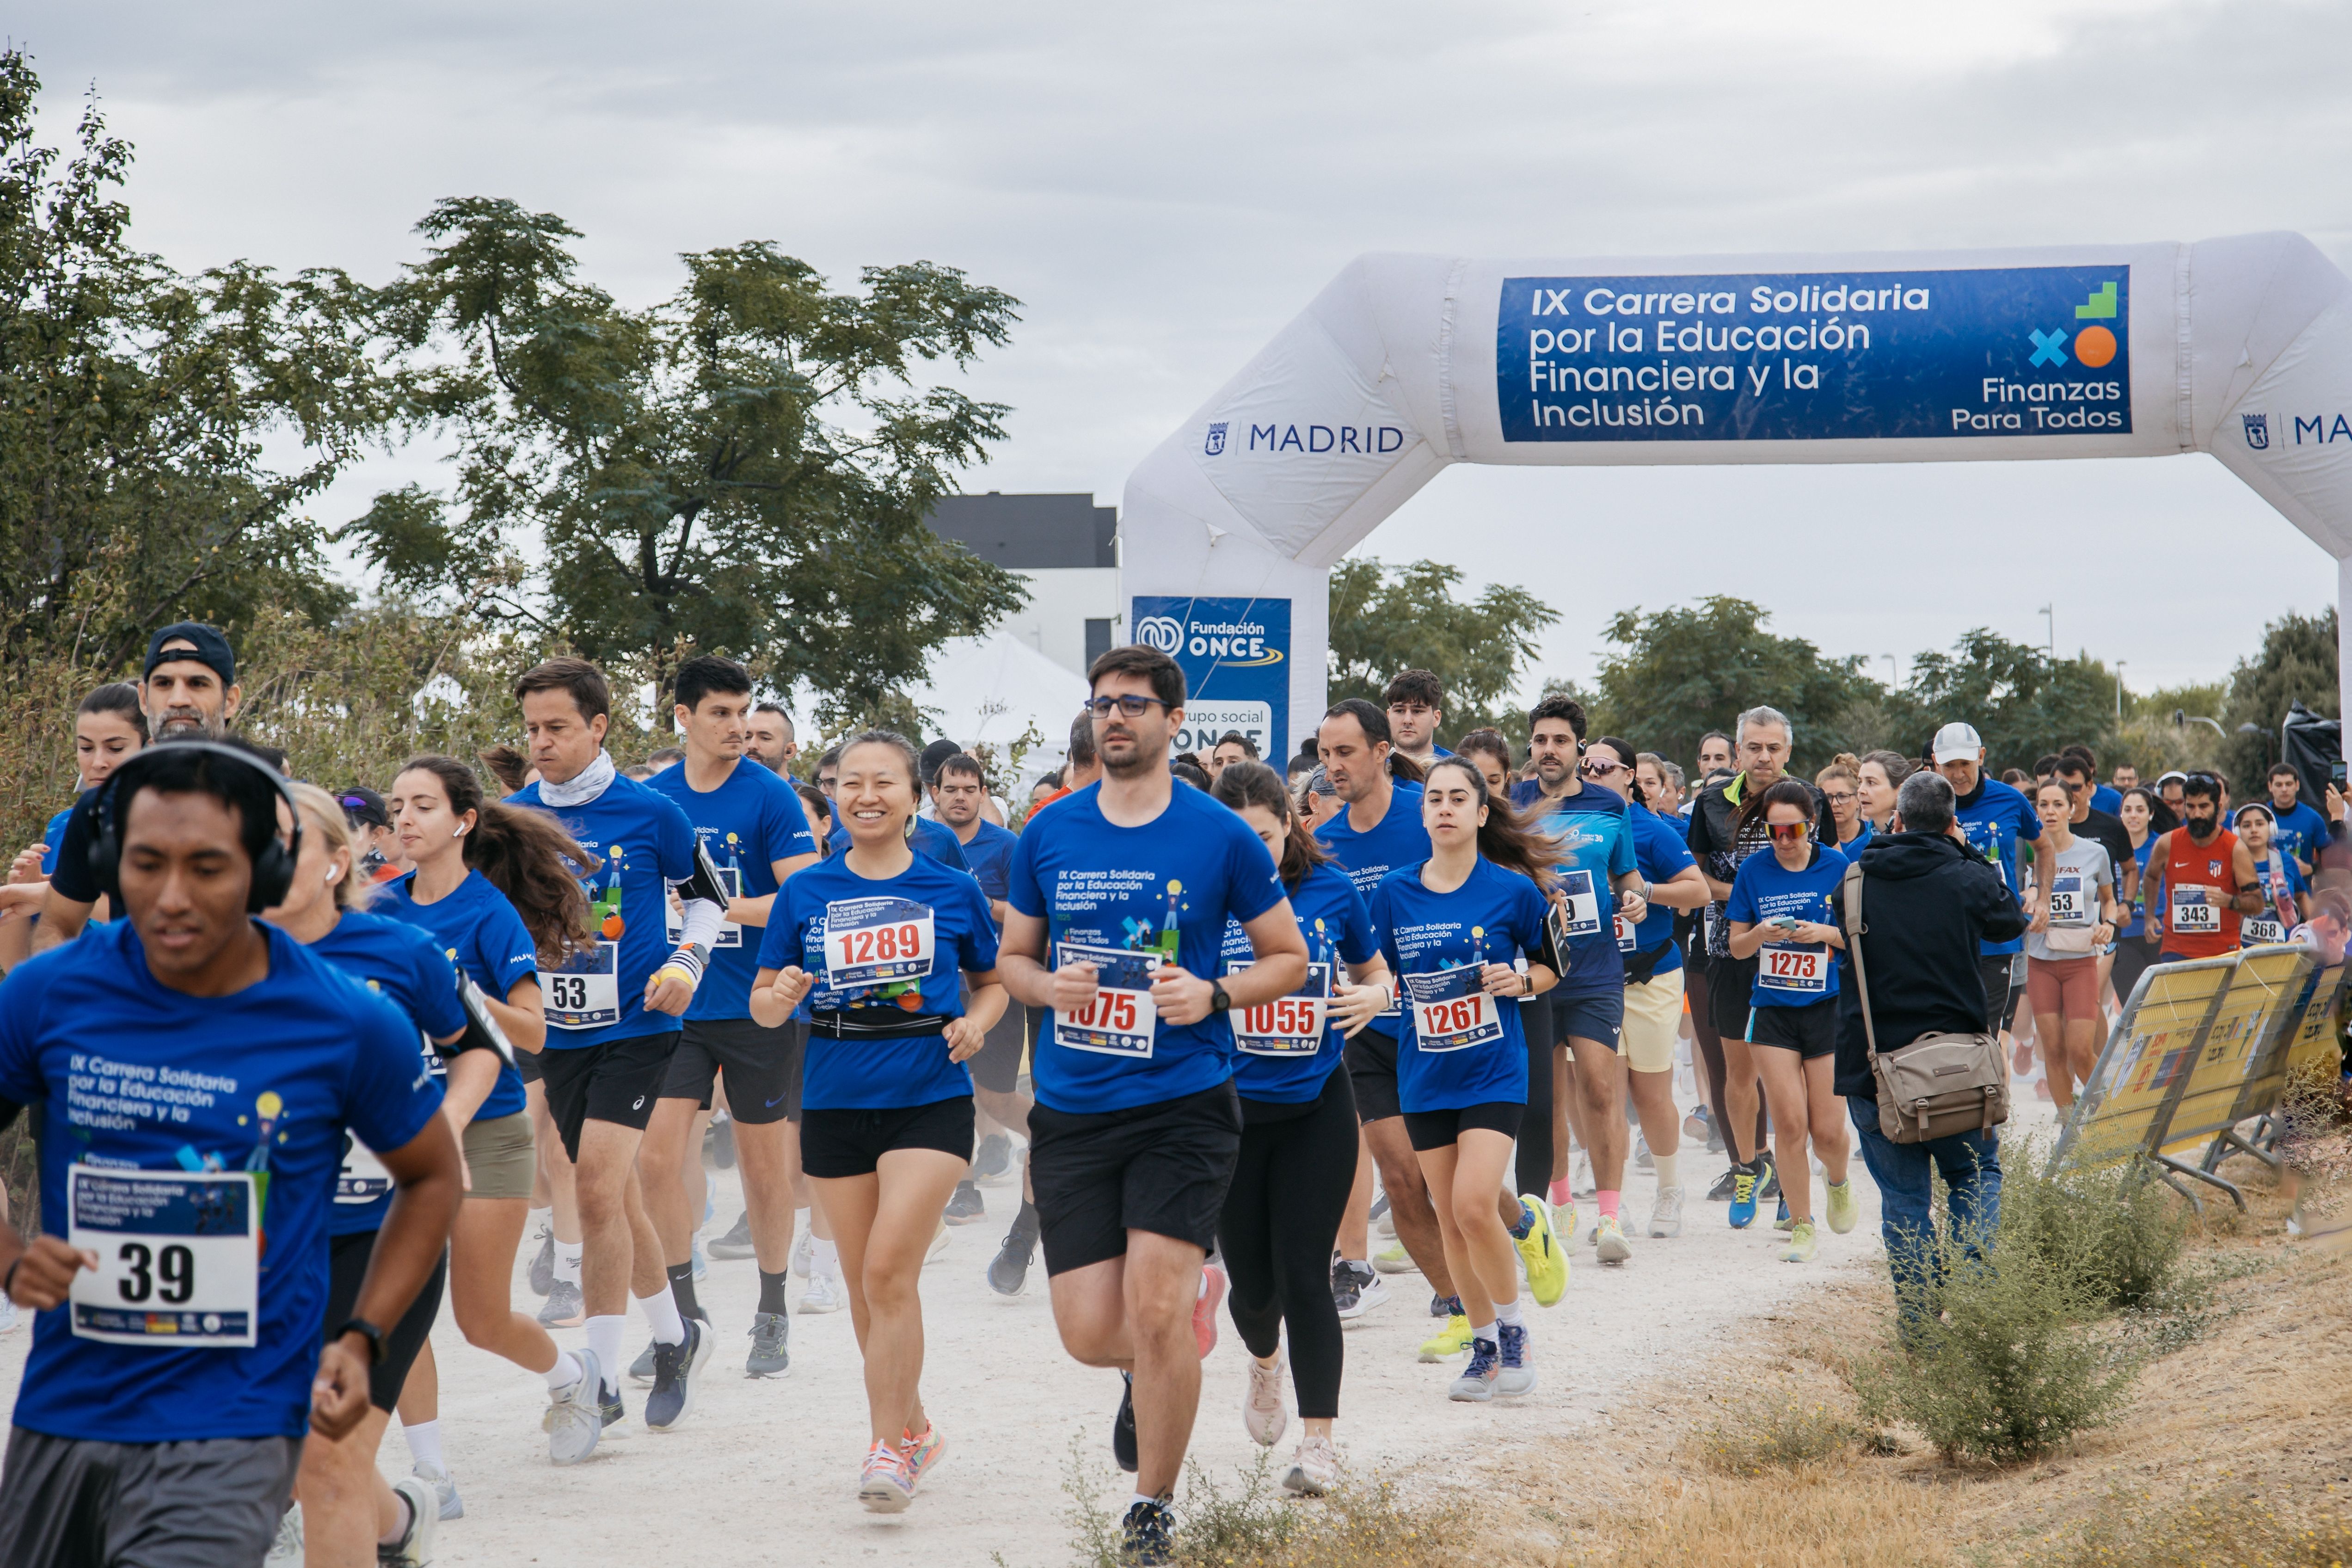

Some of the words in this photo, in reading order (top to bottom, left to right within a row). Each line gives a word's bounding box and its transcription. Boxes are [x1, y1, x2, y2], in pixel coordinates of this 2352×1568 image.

[1532, 289, 1571, 315] IX
[1584, 288, 1736, 315] Carrera
[1750, 283, 1929, 313] Solidaria
[1530, 328, 1596, 360] por
[1609, 321, 1643, 352] la
[1658, 316, 1869, 351] Educación
[1530, 359, 1735, 392] Financiera
[1748, 365, 1770, 396] y
[1784, 358, 1818, 389] la
[1983, 377, 2120, 403] Finanzas
[1533, 396, 1704, 426] Inclusión
[1952, 409, 2021, 430] Para
[2030, 406, 2122, 428] Todos
[1249, 424, 1404, 454] MADRID
[1190, 621, 1265, 635] Fundación
[1189, 637, 1265, 657] ONCE
[1183, 713, 1217, 725] rupo
[1221, 710, 1263, 723] social
[1595, 834, 1603, 842] 30
[1058, 870, 1069, 879] IX
[1069, 870, 1107, 879] Carrera
[1109, 870, 1155, 880] Solidaria
[1361, 864, 1389, 875] Solidaria
[1057, 882, 1074, 891] por
[1075, 881, 1085, 890] la
[1087, 880, 1142, 890] Educación
[1351, 873, 1384, 885] ducación
[1056, 891, 1107, 900] Financiera
[1109, 892, 1117, 902] y
[1118, 891, 1129, 900] la
[839, 904, 863, 912] Carrera
[851, 906, 884, 916] Educación
[1055, 900, 1097, 911] Inclusión
[1761, 907, 1790, 916] Financiera
[810, 916, 817, 926] IX
[831, 915, 864, 923] Financiera
[2181, 907, 2209, 922] 343
[1400, 925, 1424, 935] Carrera
[1426, 922, 1462, 931] Solidaria
[1411, 930, 1452, 941] Educación
[2250, 922, 2276, 937] 368
[806, 944, 824, 953] Inclu
[838, 924, 920, 965] 1289
[1397, 941, 1425, 952] Financiera
[1400, 950, 1420, 960] Inclusión
[1769, 952, 1816, 978] 1273
[1422, 981, 1450, 989] Educación
[1432, 974, 1456, 984] Solidaria
[553, 977, 586, 1009] 53
[1244, 1001, 1314, 1034] 1055
[1423, 996, 1481, 1034] 1267
[70, 1053, 88, 1072] IX
[88, 1056, 156, 1082] Carrera
[159, 1065, 238, 1094] Solidaria
[98, 1076, 117, 1095] la
[119, 1078, 215, 1108] Educación
[156, 1105, 168, 1122] y
[172, 1104, 191, 1123] la
[118, 1243, 193, 1304] 39
